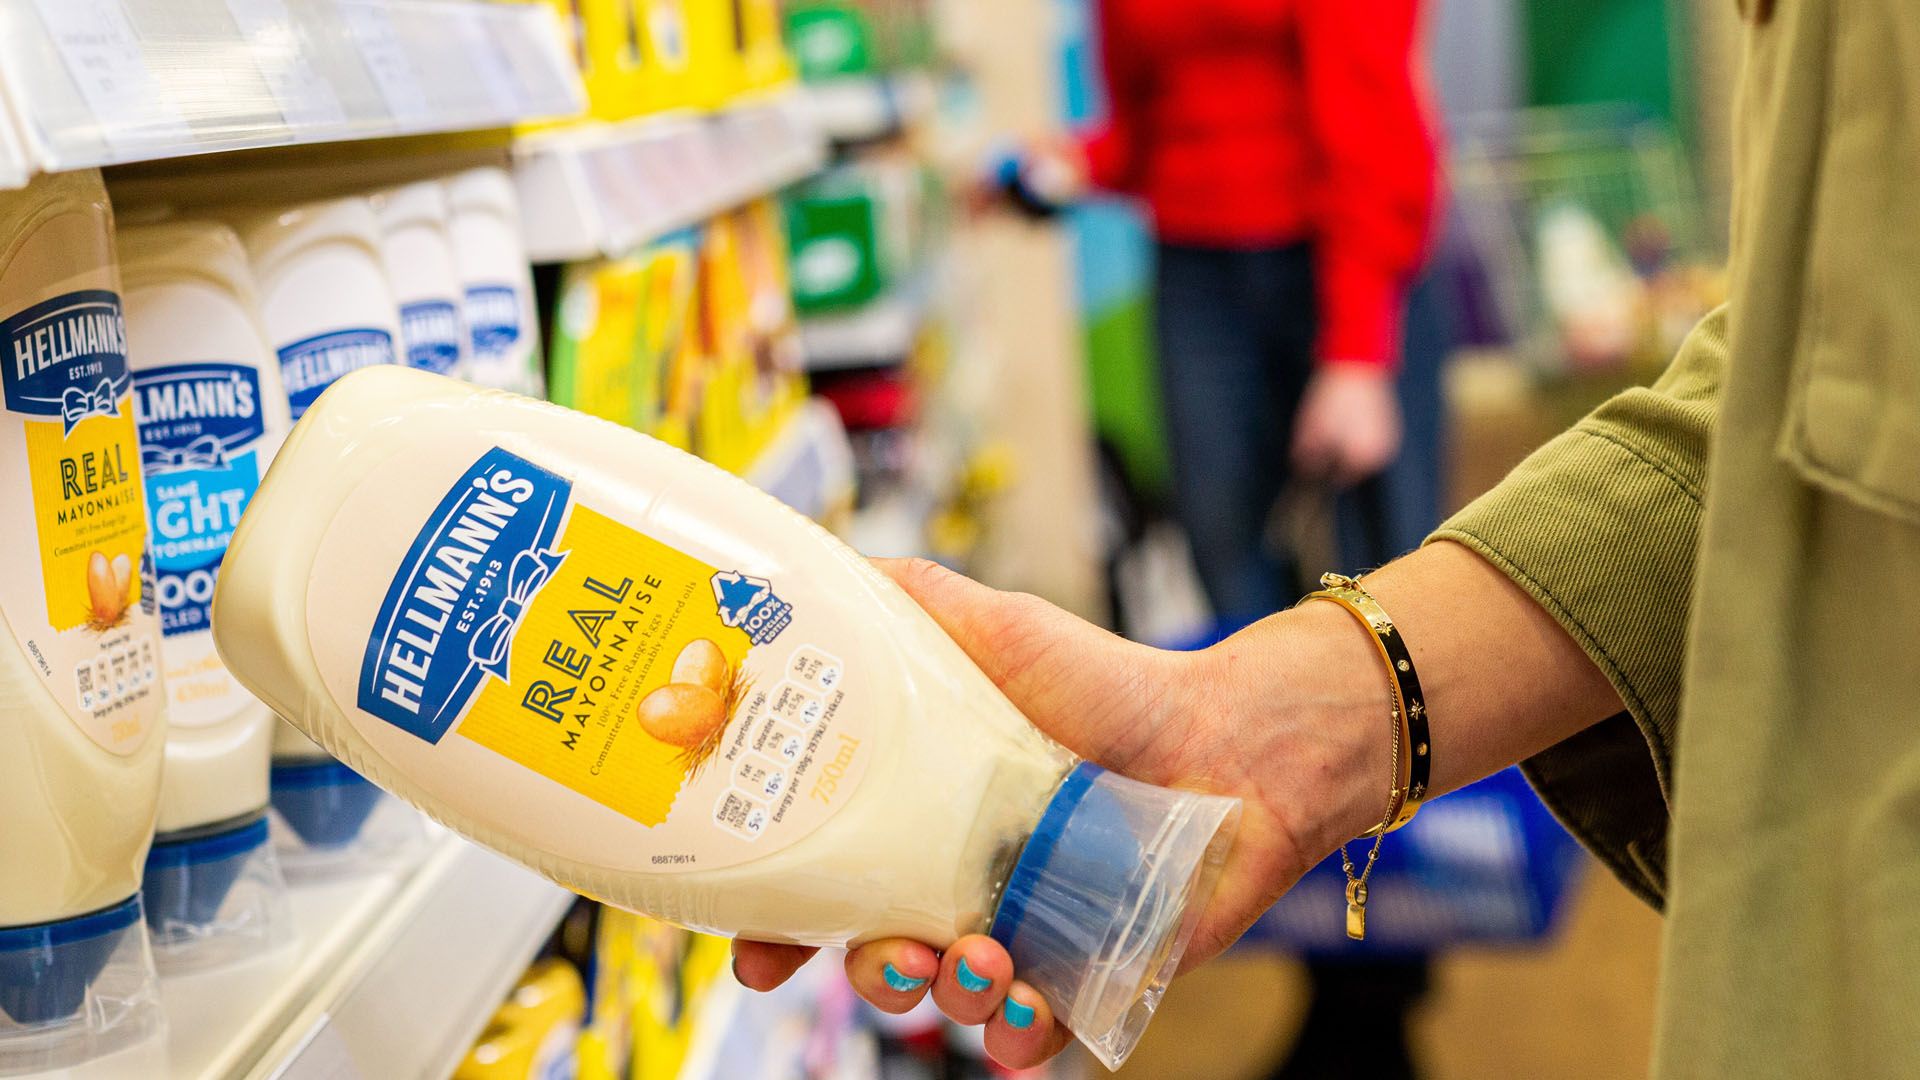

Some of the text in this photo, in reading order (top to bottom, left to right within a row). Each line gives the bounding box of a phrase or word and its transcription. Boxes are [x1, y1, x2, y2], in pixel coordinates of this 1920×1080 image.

[14, 308, 127, 381] HELLMANN'S
[134, 371, 255, 424] LMANN'S
[60, 444, 128, 500] REAL
[58, 488, 134, 525] MAYONNAISE
[156, 488, 244, 538] GHT
[381, 469, 534, 714] HELLMANN'S
[456, 559, 503, 634] EST.1913
[744, 598, 781, 634] 100%
[751, 604, 791, 644] RECYCLABLE
[765, 617, 789, 642] BOTTLE
[521, 576, 634, 724] REAL
[561, 574, 663, 751] MAYONNAISE
[610, 674, 628, 700] Free
[624, 640, 648, 673] Range
[644, 612, 663, 638] Eggs
[795, 656, 809, 673] Salt
[590, 580, 698, 776] Committed to sustainably sourced oils
[773, 687, 793, 713] Sugars
[725, 744, 735, 761] Per
[734, 713, 754, 746] portion
[752, 718, 776, 752] Saturates
[739, 764, 752, 779] Fat
[810, 732, 862, 807] 750ml
[717, 794, 738, 821] Energy
[772, 796, 795, 824] Energy
[788, 779, 800, 797] per
[651, 854, 696, 865] 68879614
